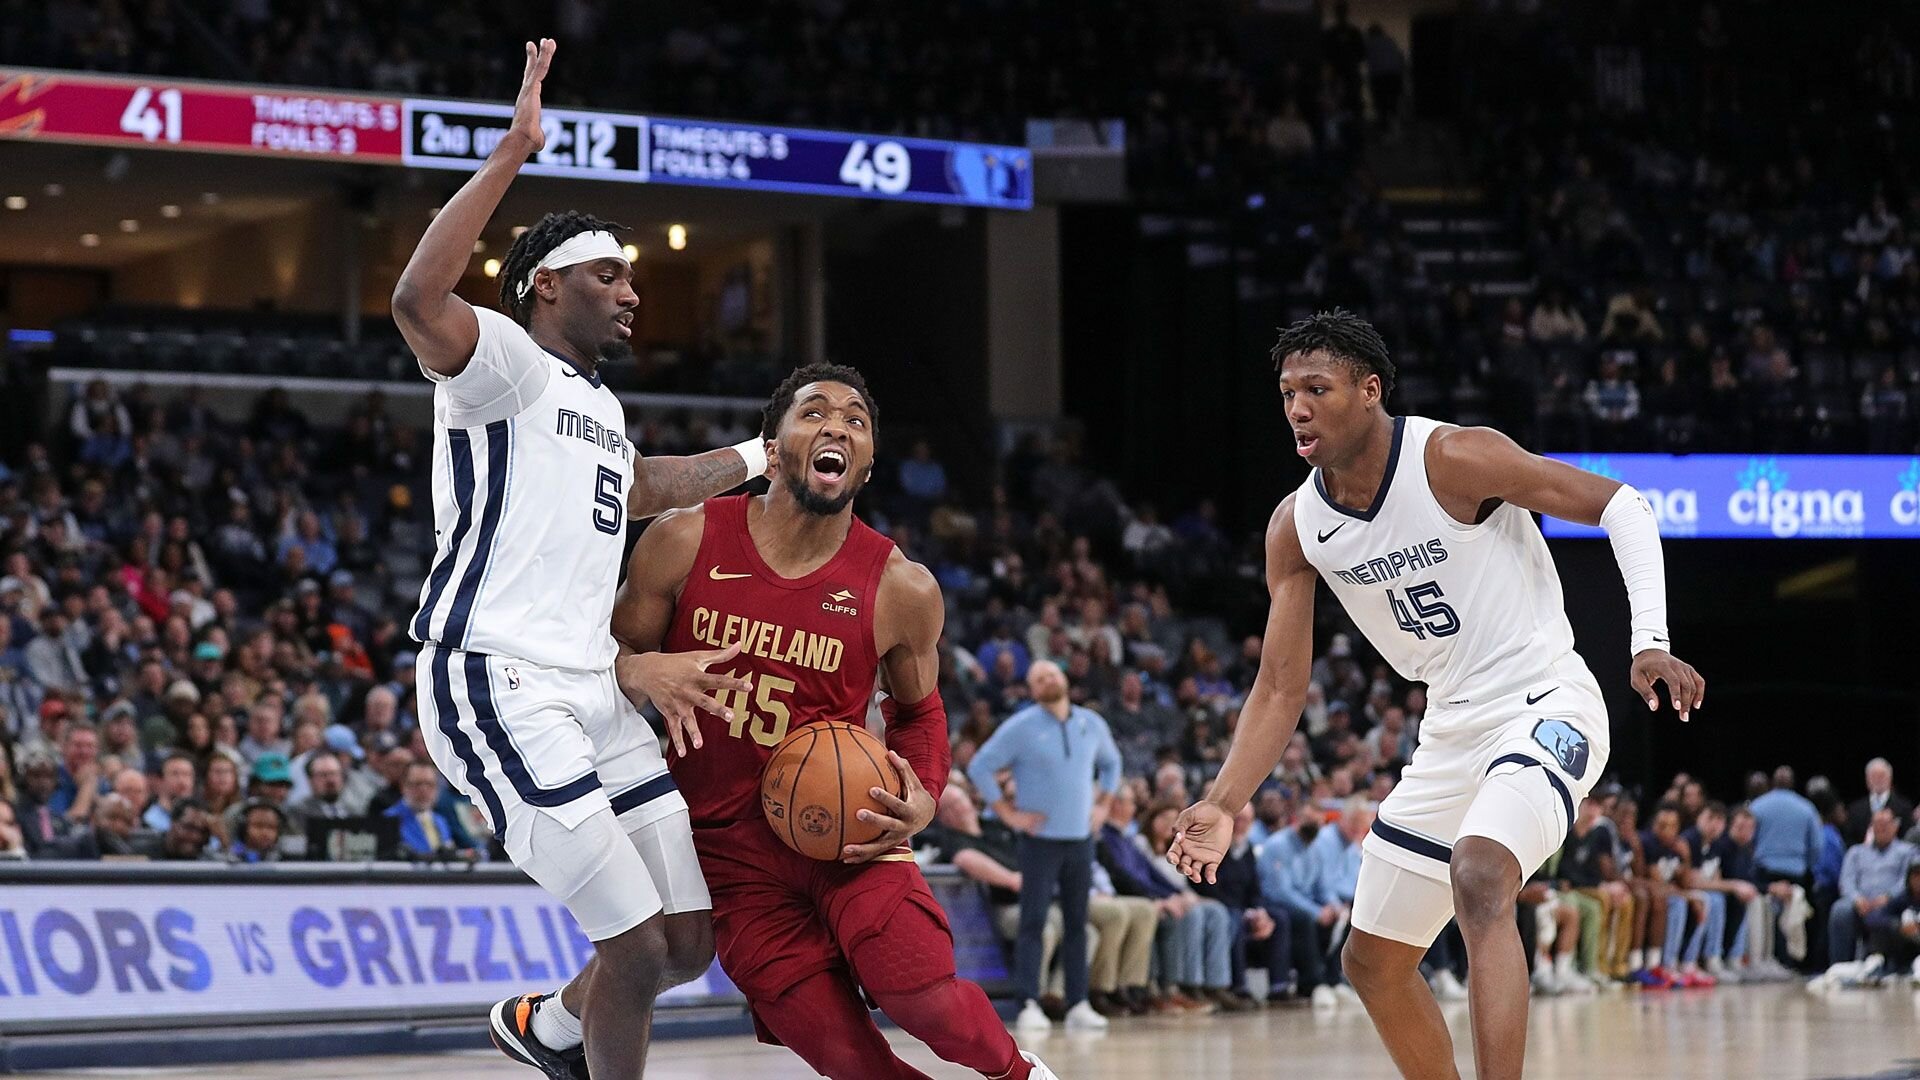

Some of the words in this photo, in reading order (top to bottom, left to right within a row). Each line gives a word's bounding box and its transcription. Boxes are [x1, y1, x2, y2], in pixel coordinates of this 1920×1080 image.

[119, 86, 183, 144] 41
[537, 115, 616, 169] 2:12
[840, 139, 911, 195] 49
[556, 407, 631, 473] MEMPH
[592, 463, 623, 536] 5
[1727, 477, 1865, 538] cigna
[1332, 538, 1449, 586] MEMPHIS
[821, 602, 858, 616] CLIFFS
[1385, 580, 1461, 640] 45
[692, 606, 844, 673] CLEVELAND
[709, 667, 796, 748] 45
[0, 907, 214, 997] IORS
